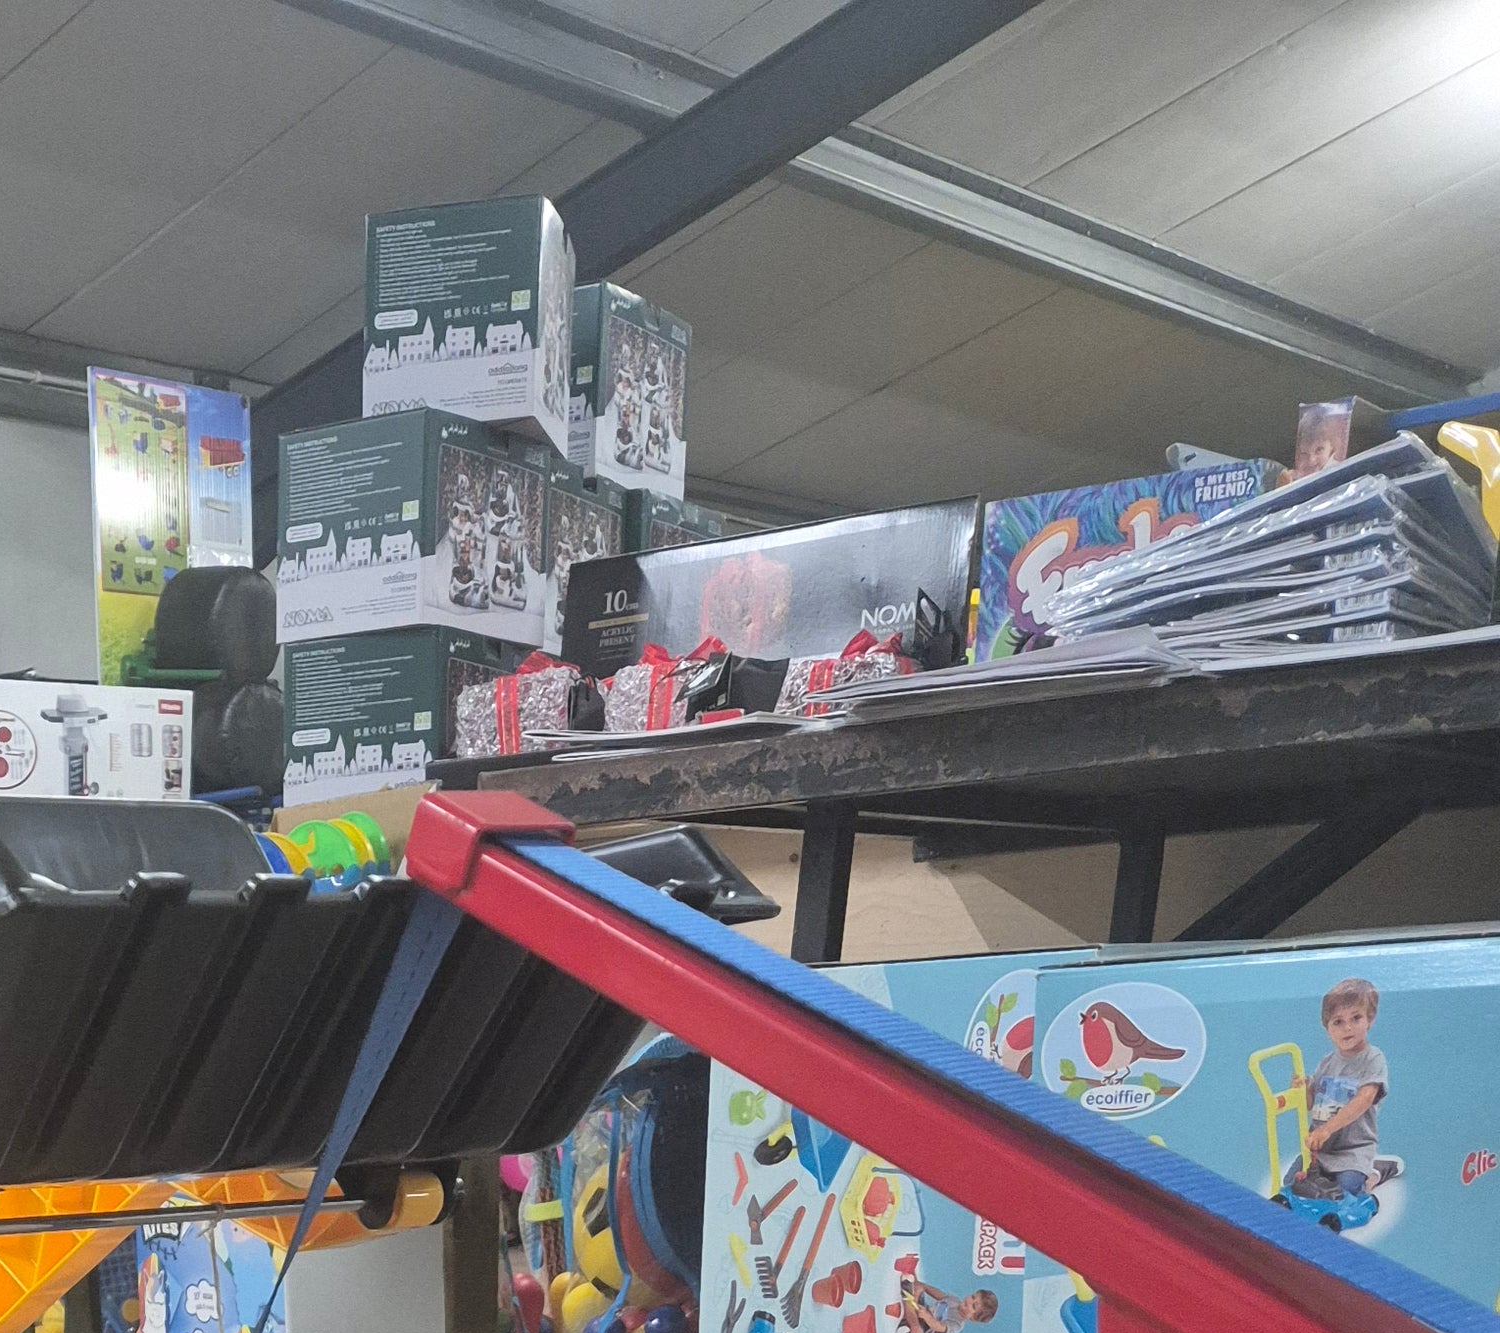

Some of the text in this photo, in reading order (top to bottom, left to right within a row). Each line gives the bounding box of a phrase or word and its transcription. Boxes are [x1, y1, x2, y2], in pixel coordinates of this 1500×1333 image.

[1207, 473, 1224, 486] MY
[1226, 468, 1249, 482] BEST
[1195, 477, 1255, 503] FRIEND?
[283, 606, 334, 628] NOMA
[861, 602, 917, 629] NOM
[600, 634, 637, 648] PRESENT
[601, 625, 635, 637] ACRYLIC
